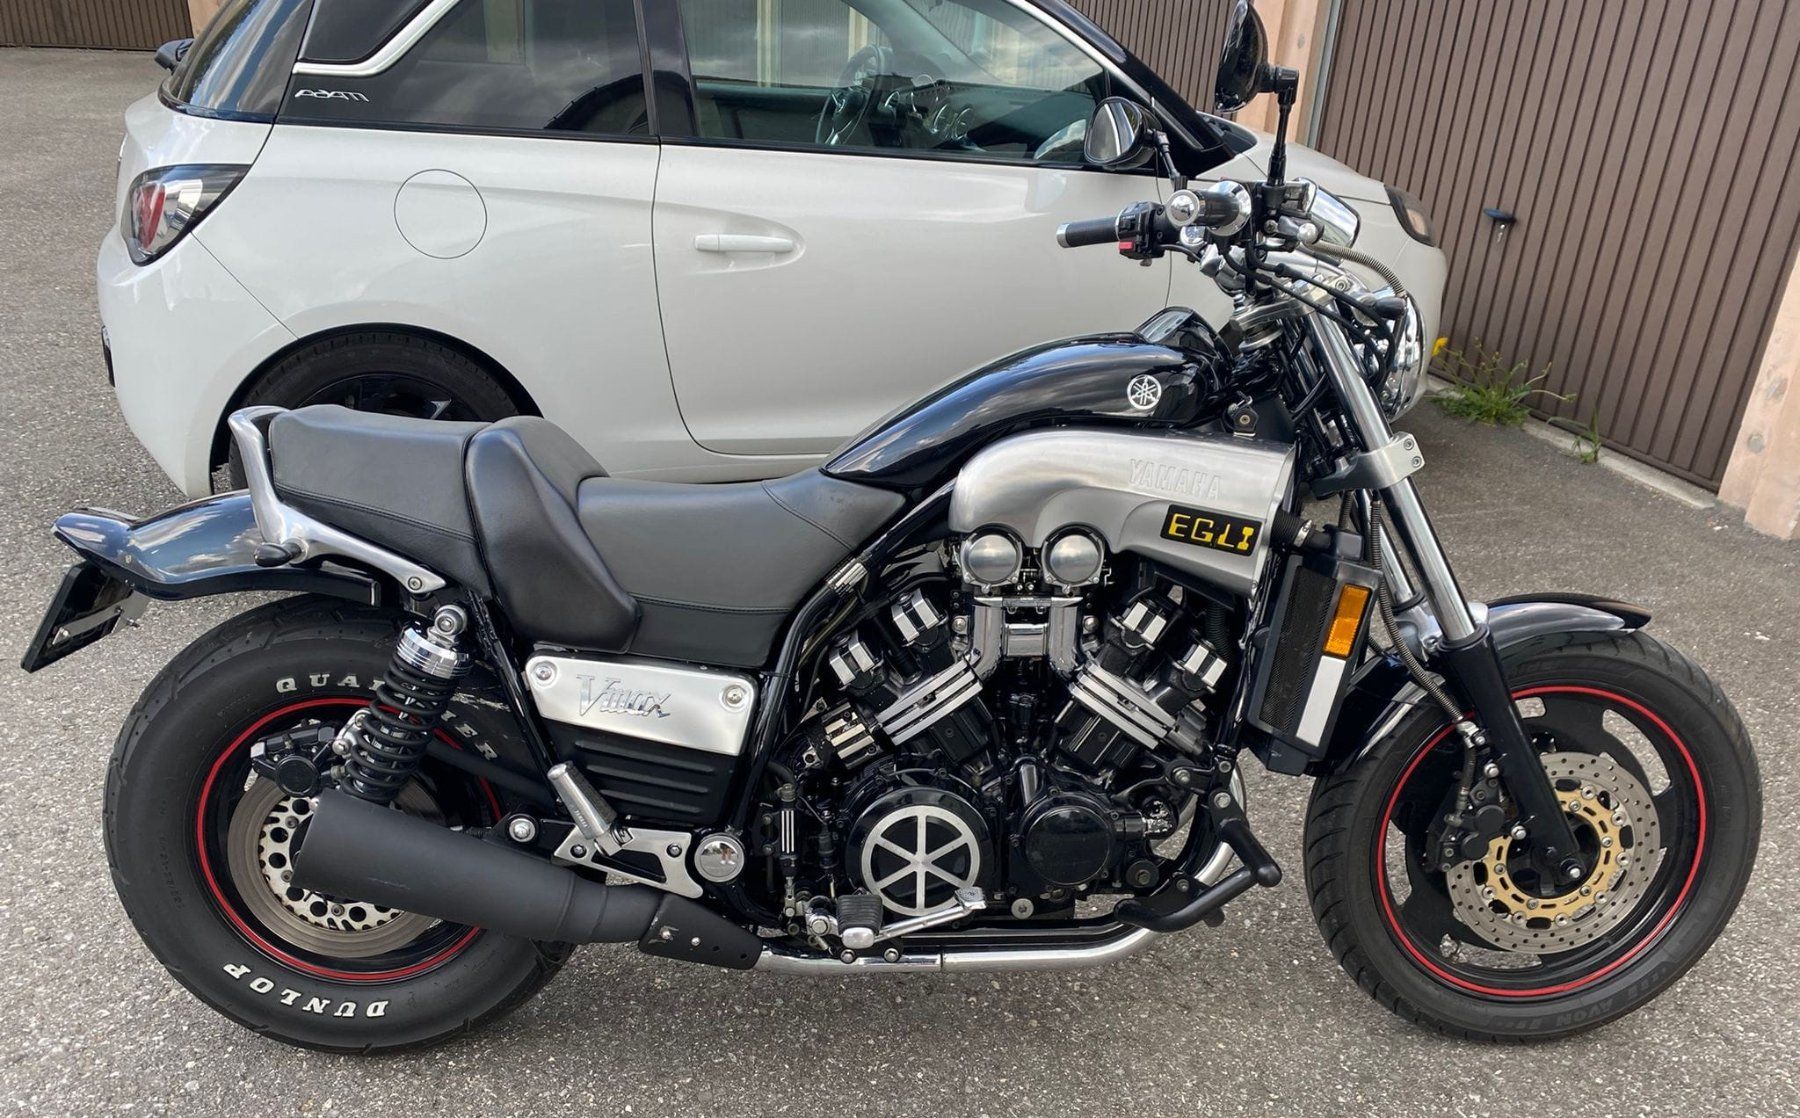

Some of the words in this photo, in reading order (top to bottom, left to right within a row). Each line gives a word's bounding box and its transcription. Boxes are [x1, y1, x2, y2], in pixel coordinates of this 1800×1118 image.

[1129, 458, 1222, 501] YAMAHA
[1168, 513, 1255, 551] EGLI
[276, 673, 498, 761] QUALIER
[223, 963, 389, 1018] DUNLOP
[1556, 998, 1614, 1027] AVON
